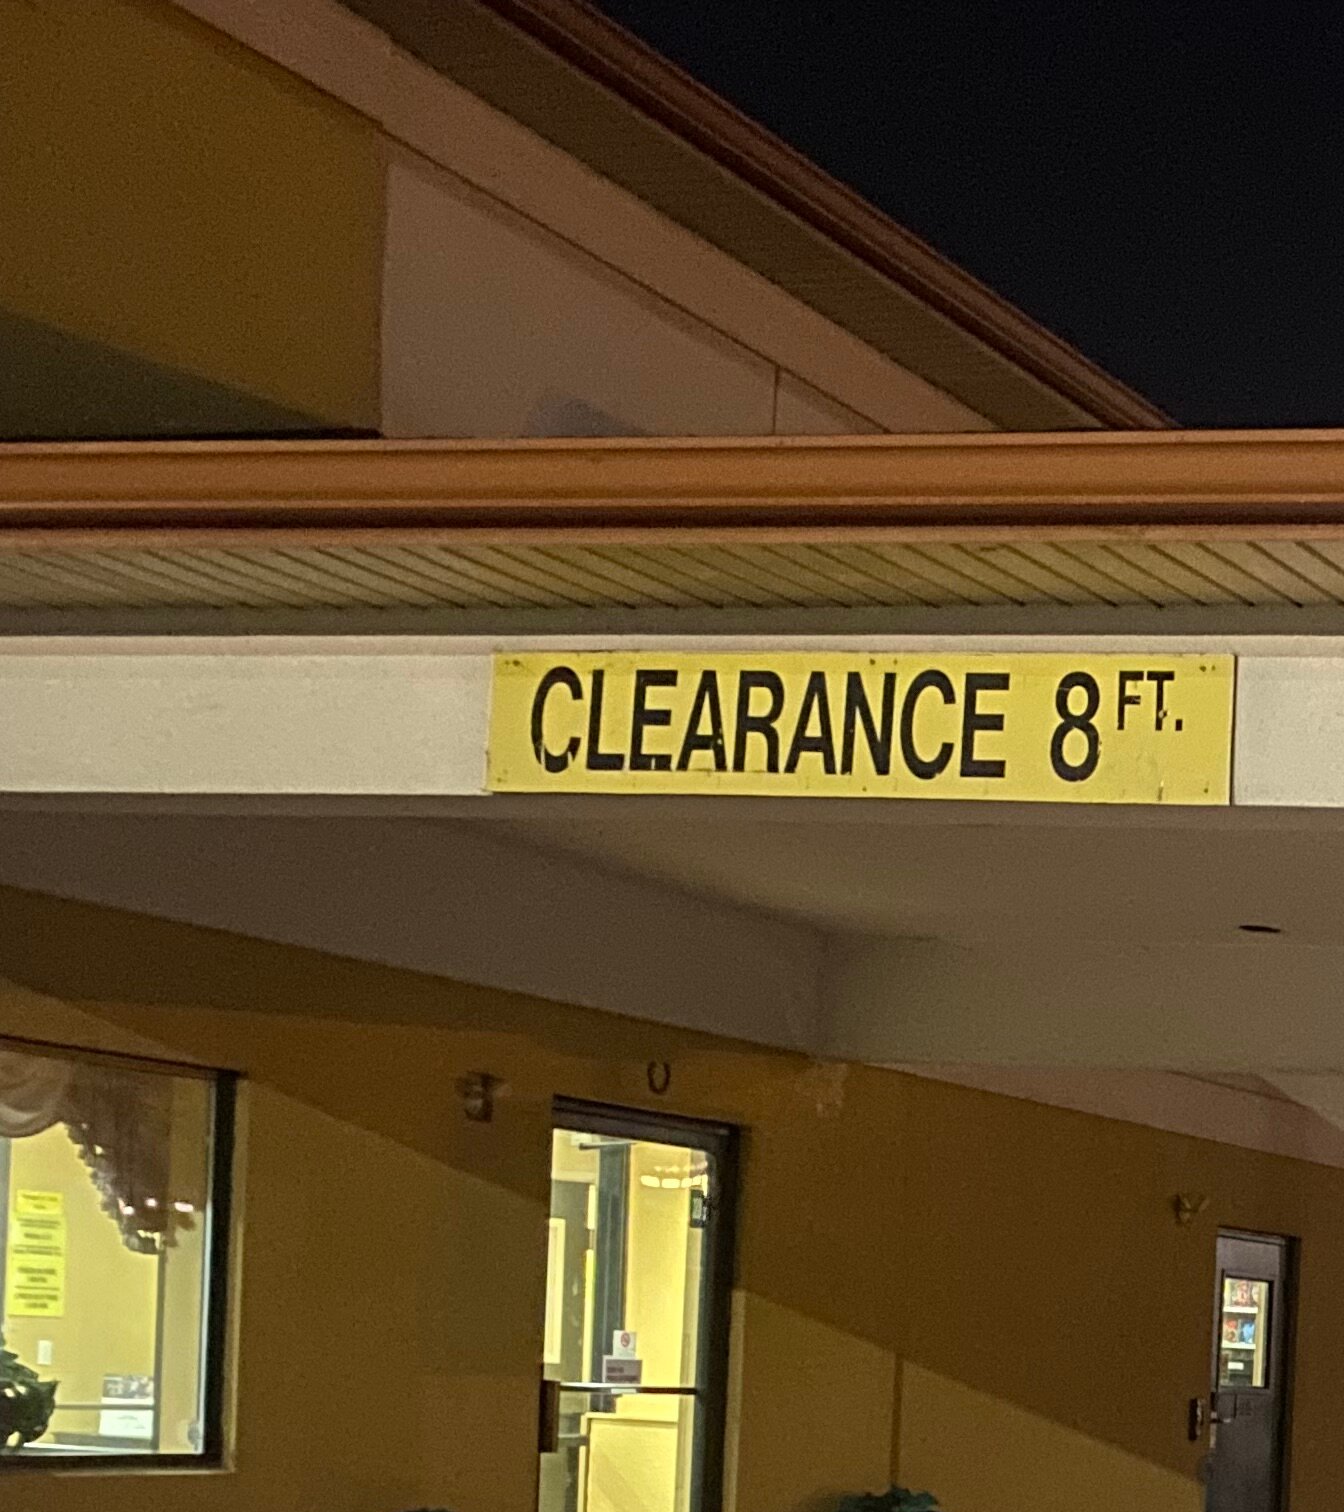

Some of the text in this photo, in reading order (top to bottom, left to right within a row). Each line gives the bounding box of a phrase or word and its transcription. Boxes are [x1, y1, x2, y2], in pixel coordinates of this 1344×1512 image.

[530, 666, 1184, 782] CLEARANCE 8 FT.
